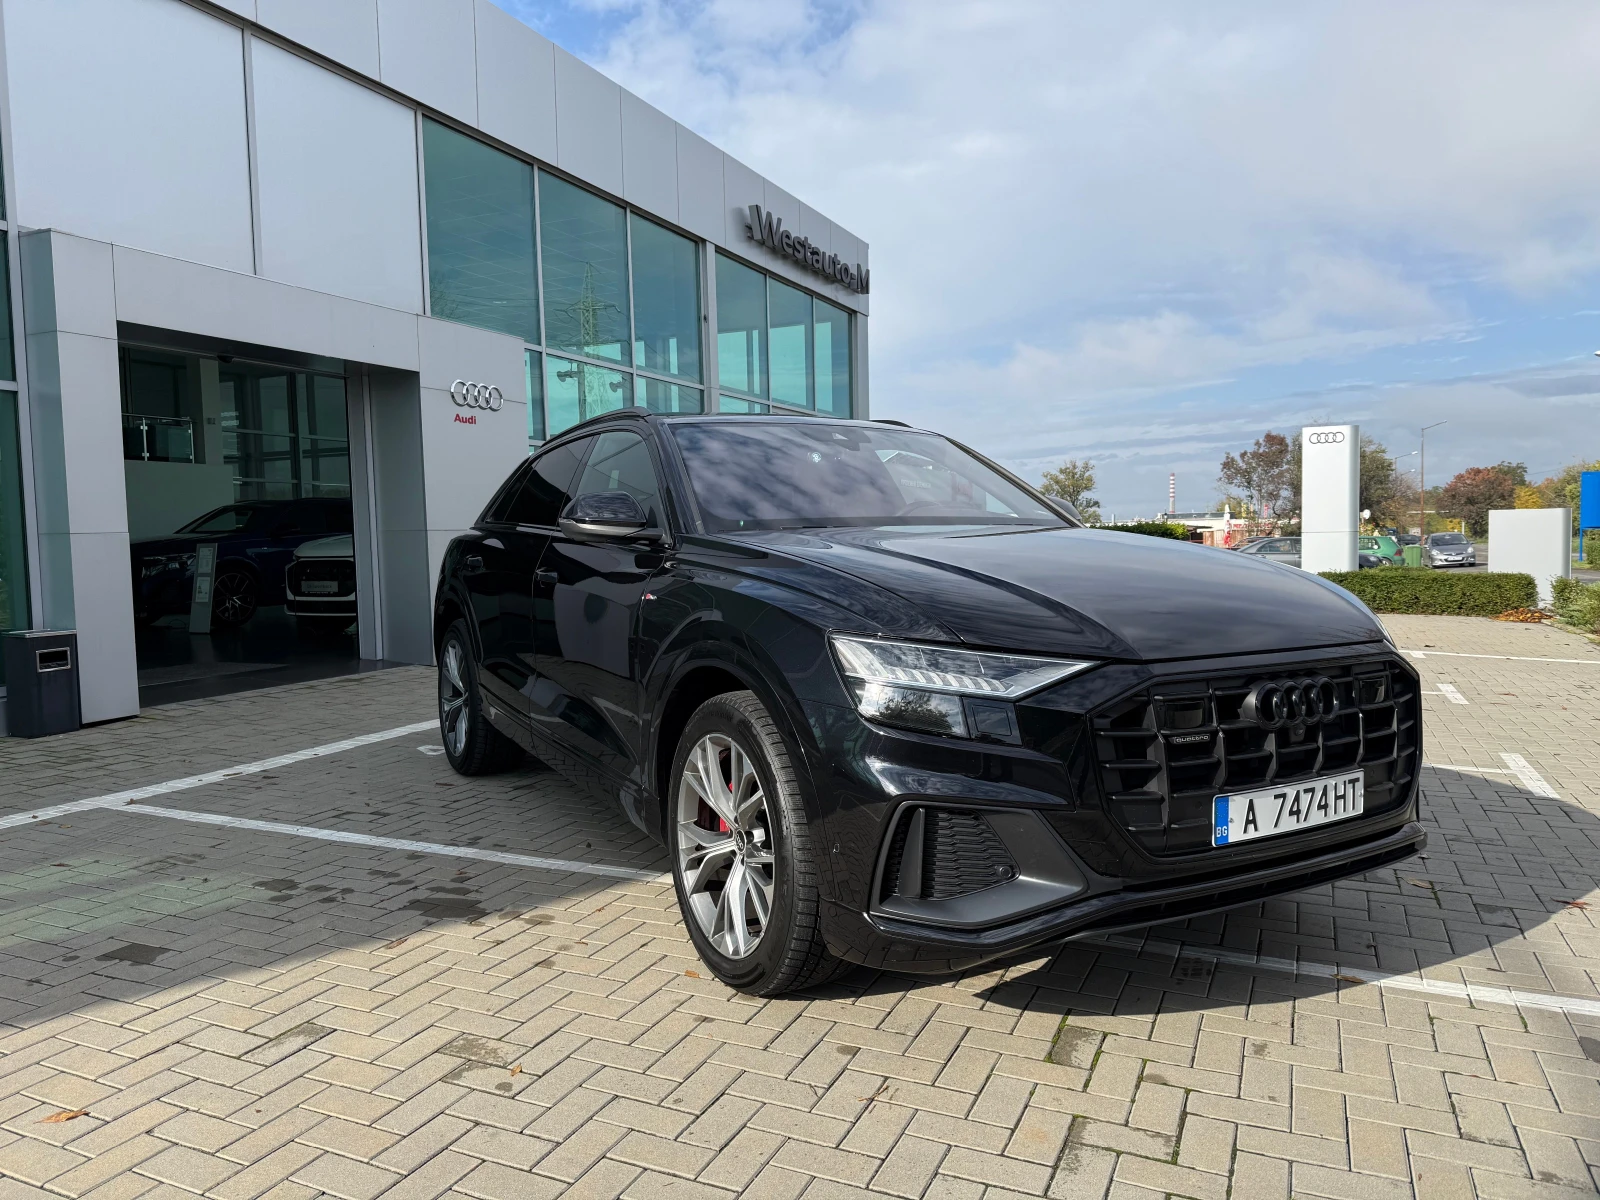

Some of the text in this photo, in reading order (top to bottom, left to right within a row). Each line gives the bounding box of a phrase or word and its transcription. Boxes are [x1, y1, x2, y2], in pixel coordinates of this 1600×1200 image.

[453, 413, 477, 425] Audi
[1173, 734, 1209, 743] quattro
[1242, 798, 1259, 834] A
[1216, 825, 1228, 838] BG
